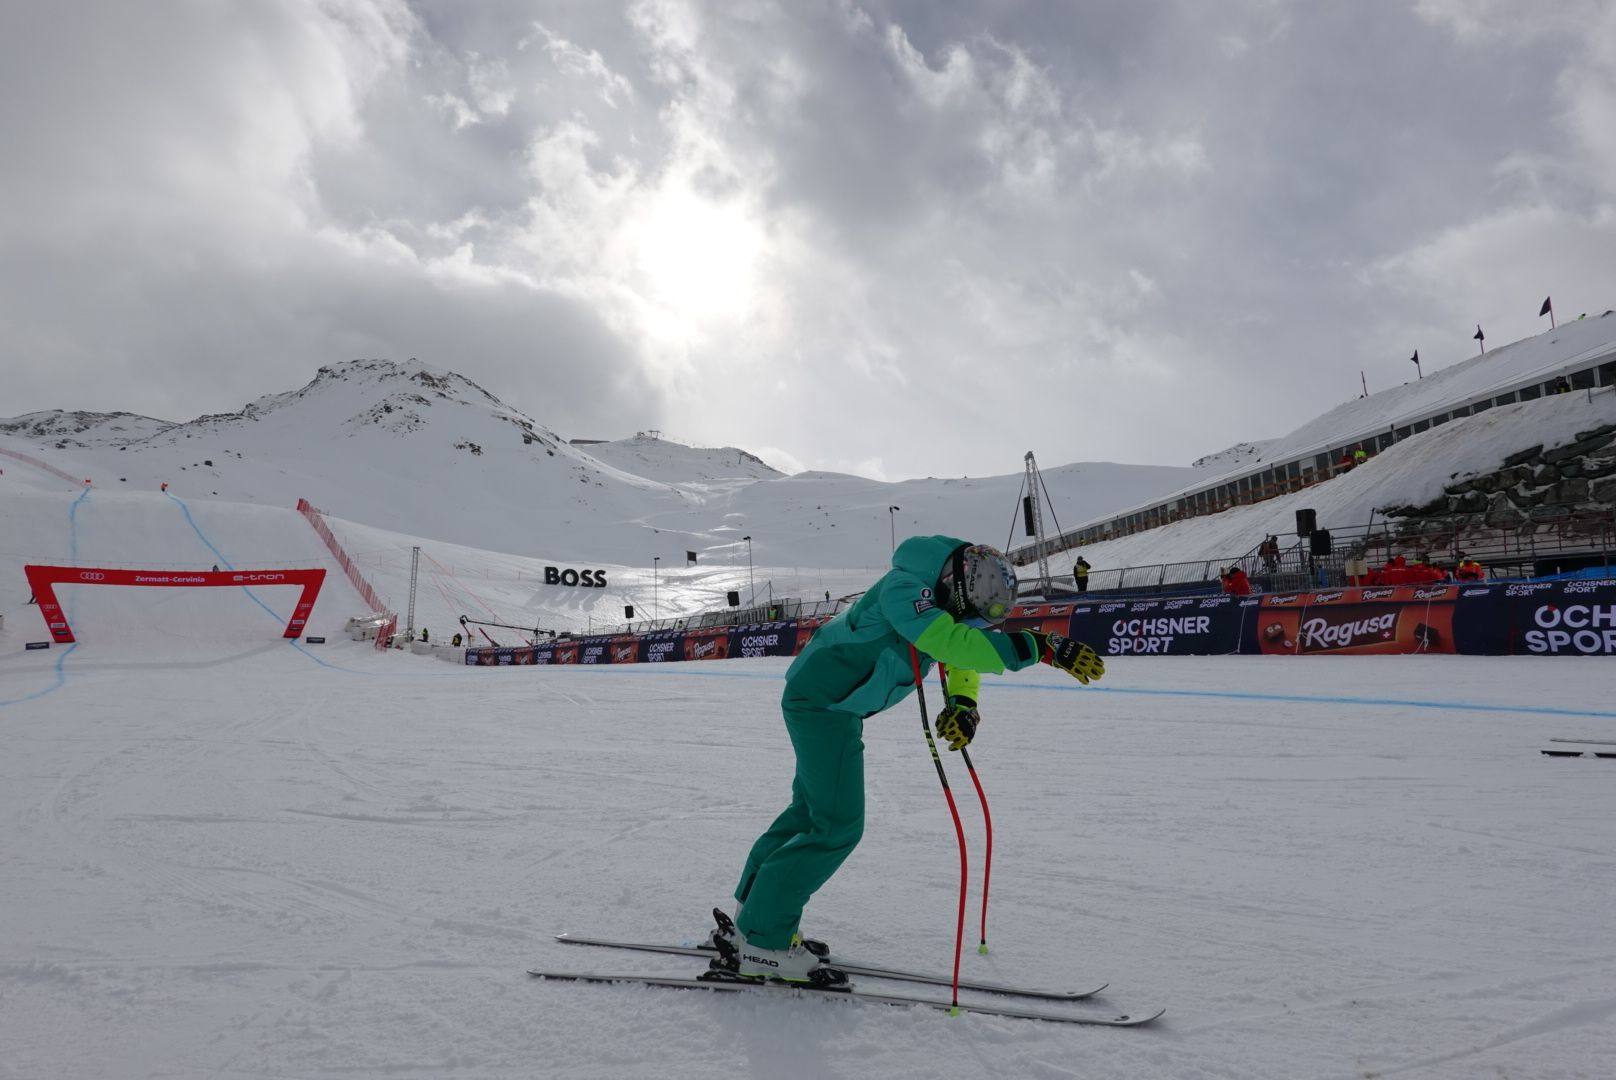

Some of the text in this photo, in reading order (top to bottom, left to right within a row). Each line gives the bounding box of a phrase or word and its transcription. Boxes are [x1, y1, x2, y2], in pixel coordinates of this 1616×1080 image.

[135, 575, 205, 583] Zermatt-Cervinia
[544, 566, 607, 588] BOSS
[1362, 589, 1393, 600] Ragusa
[1563, 586, 1597, 594] SPORT
[1112, 616, 1209, 635] OCHSNER
[1302, 613, 1395, 647] Ragusa
[741, 634, 778, 647] OCHSNER
[1108, 636, 1173, 654] SPORT
[743, 954, 779, 968] HEAD
